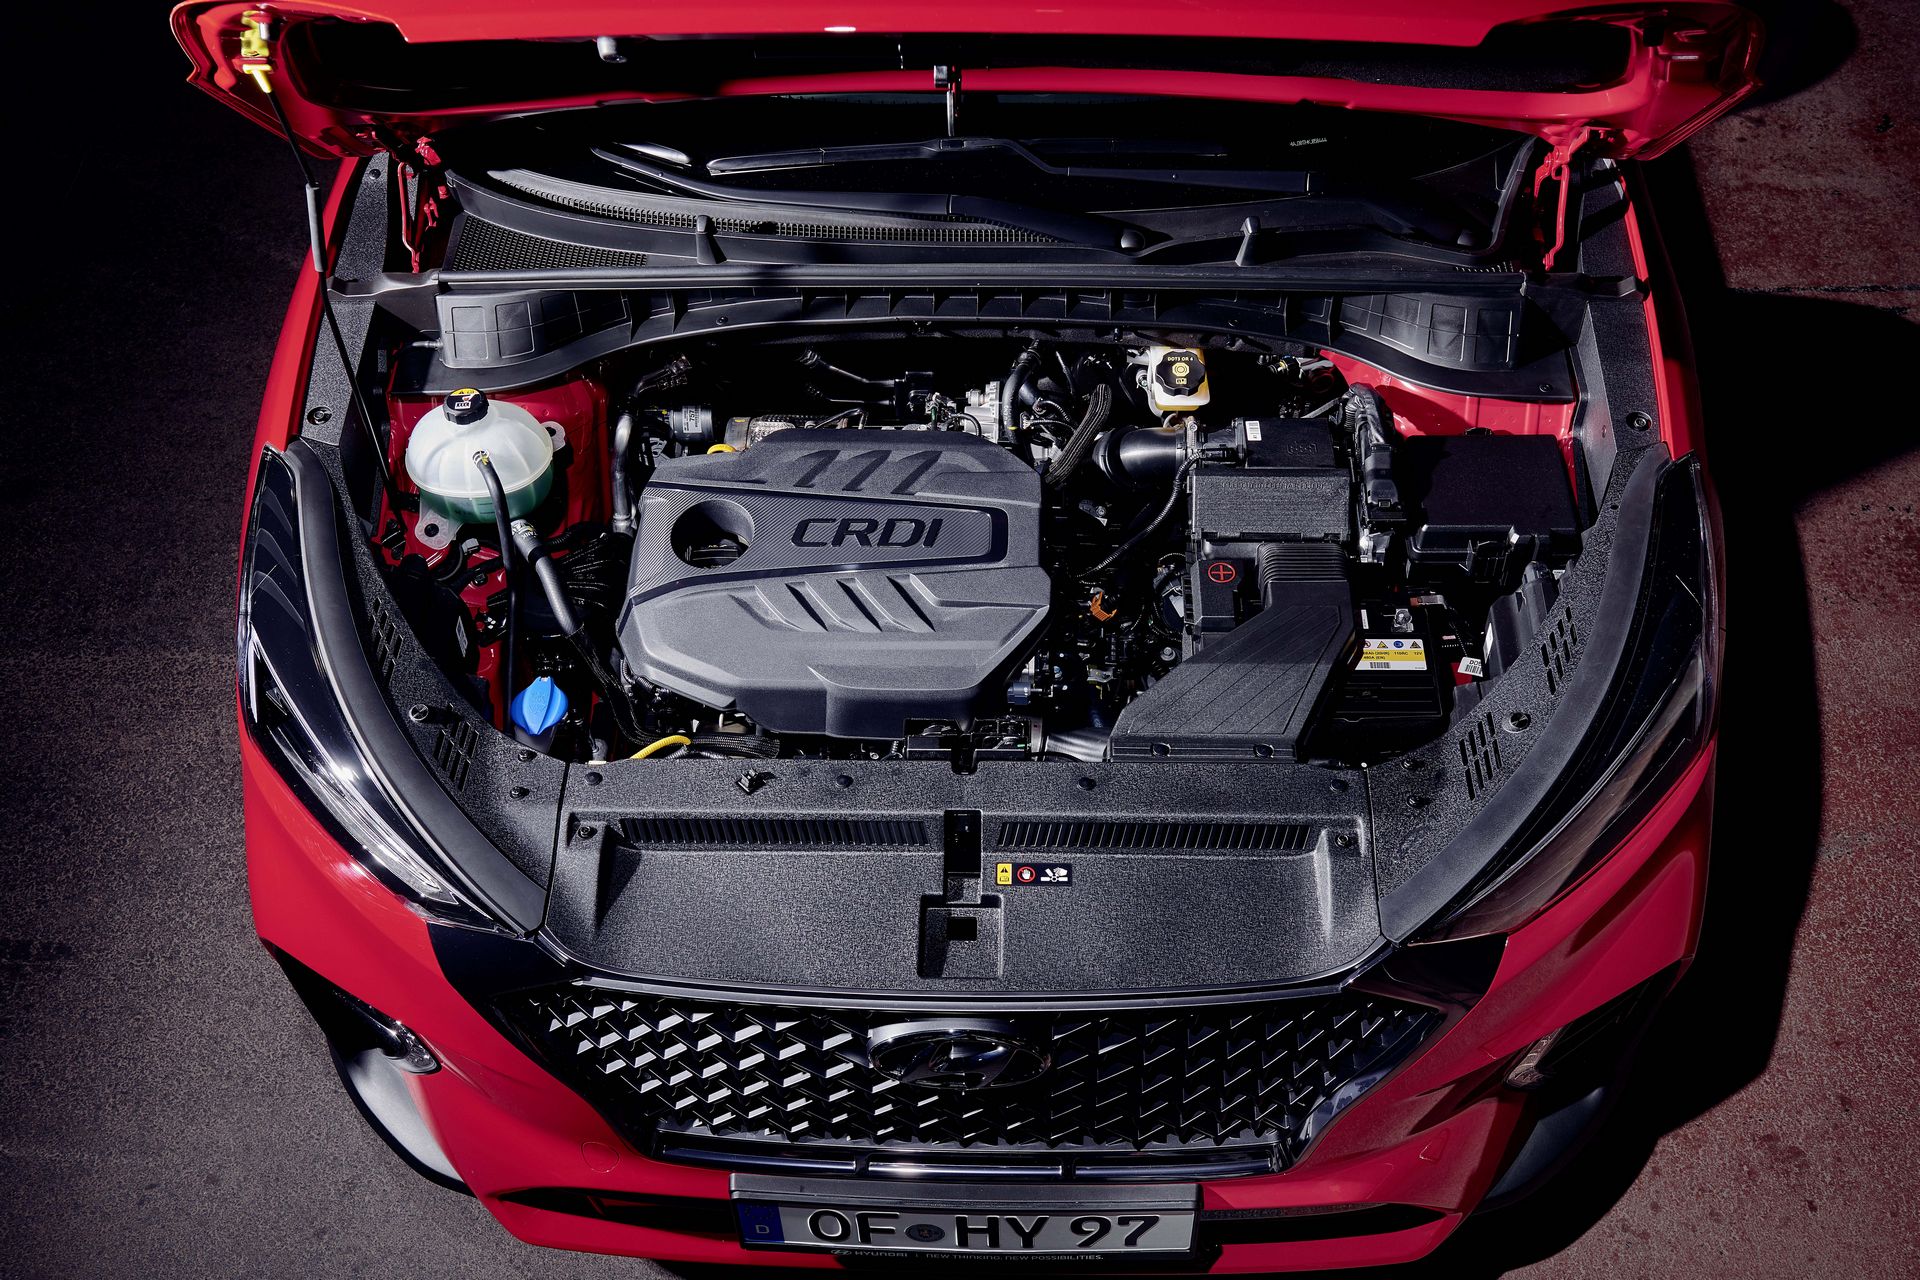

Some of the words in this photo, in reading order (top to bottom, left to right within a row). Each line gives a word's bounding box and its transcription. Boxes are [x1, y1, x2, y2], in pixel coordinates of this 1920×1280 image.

[792, 518, 943, 547] CRDI
[755, 1224, 770, 1235] D
[808, 1209, 900, 1244] OF
[955, 1214, 1050, 1249] HY
[1070, 1215, 1160, 1248] 97
